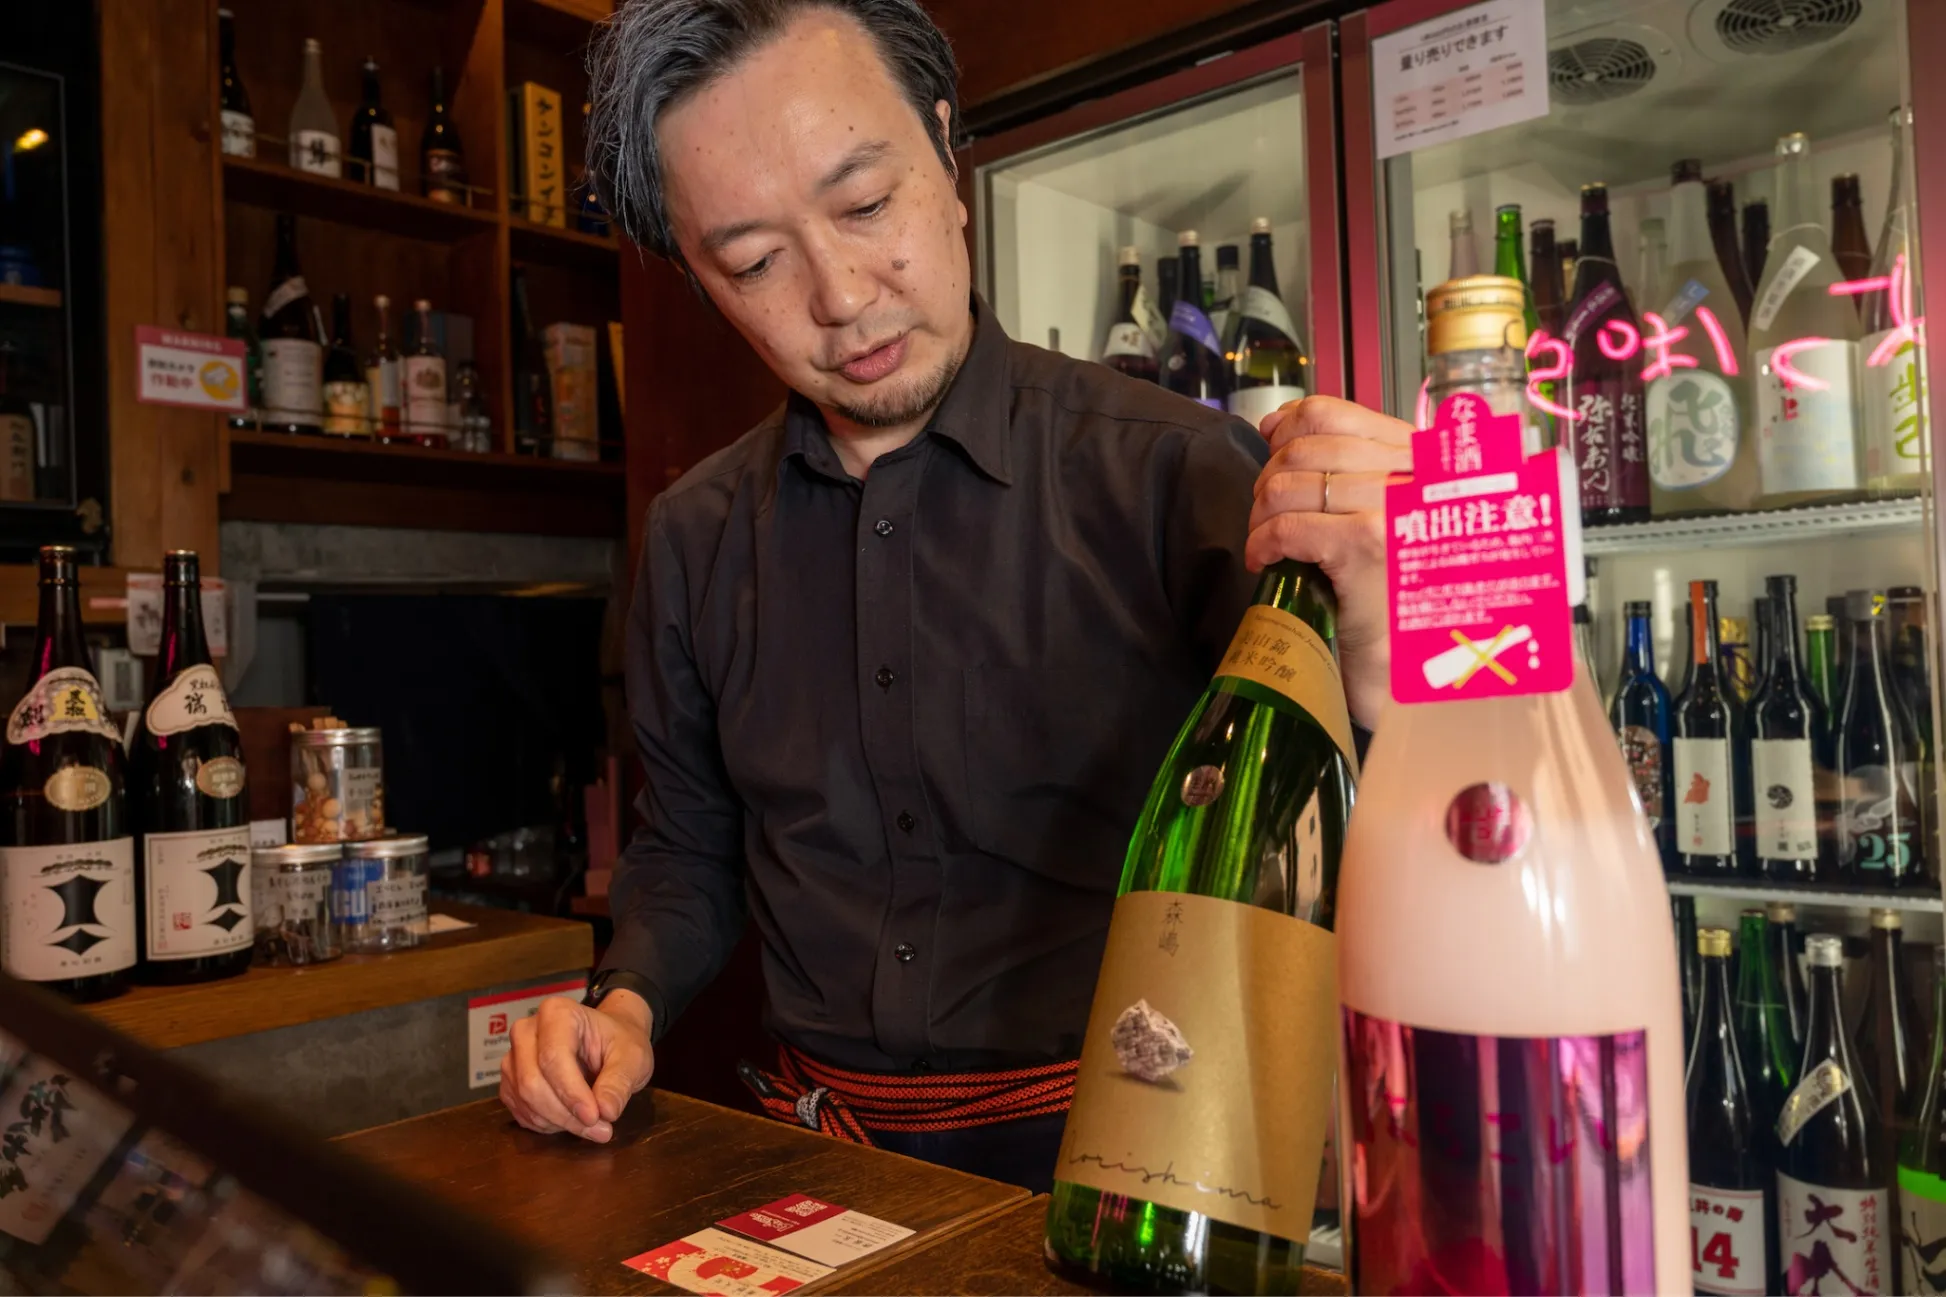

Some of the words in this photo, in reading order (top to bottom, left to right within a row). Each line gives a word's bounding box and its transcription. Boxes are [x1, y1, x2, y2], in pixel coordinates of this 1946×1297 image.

[1400, 25, 1509, 72] 量り売りできます
[161, 333, 223, 352] WARNING
[1450, 396, 1483, 474] なま酒
[1394, 492, 1553, 545] 噴出注意!
[1226, 648, 1299, 684] 純米吟醸
[1858, 831, 1913, 871] 25
[1157, 899, 1185, 958] 森嶋
[1690, 1226, 1741, 1281] 14
